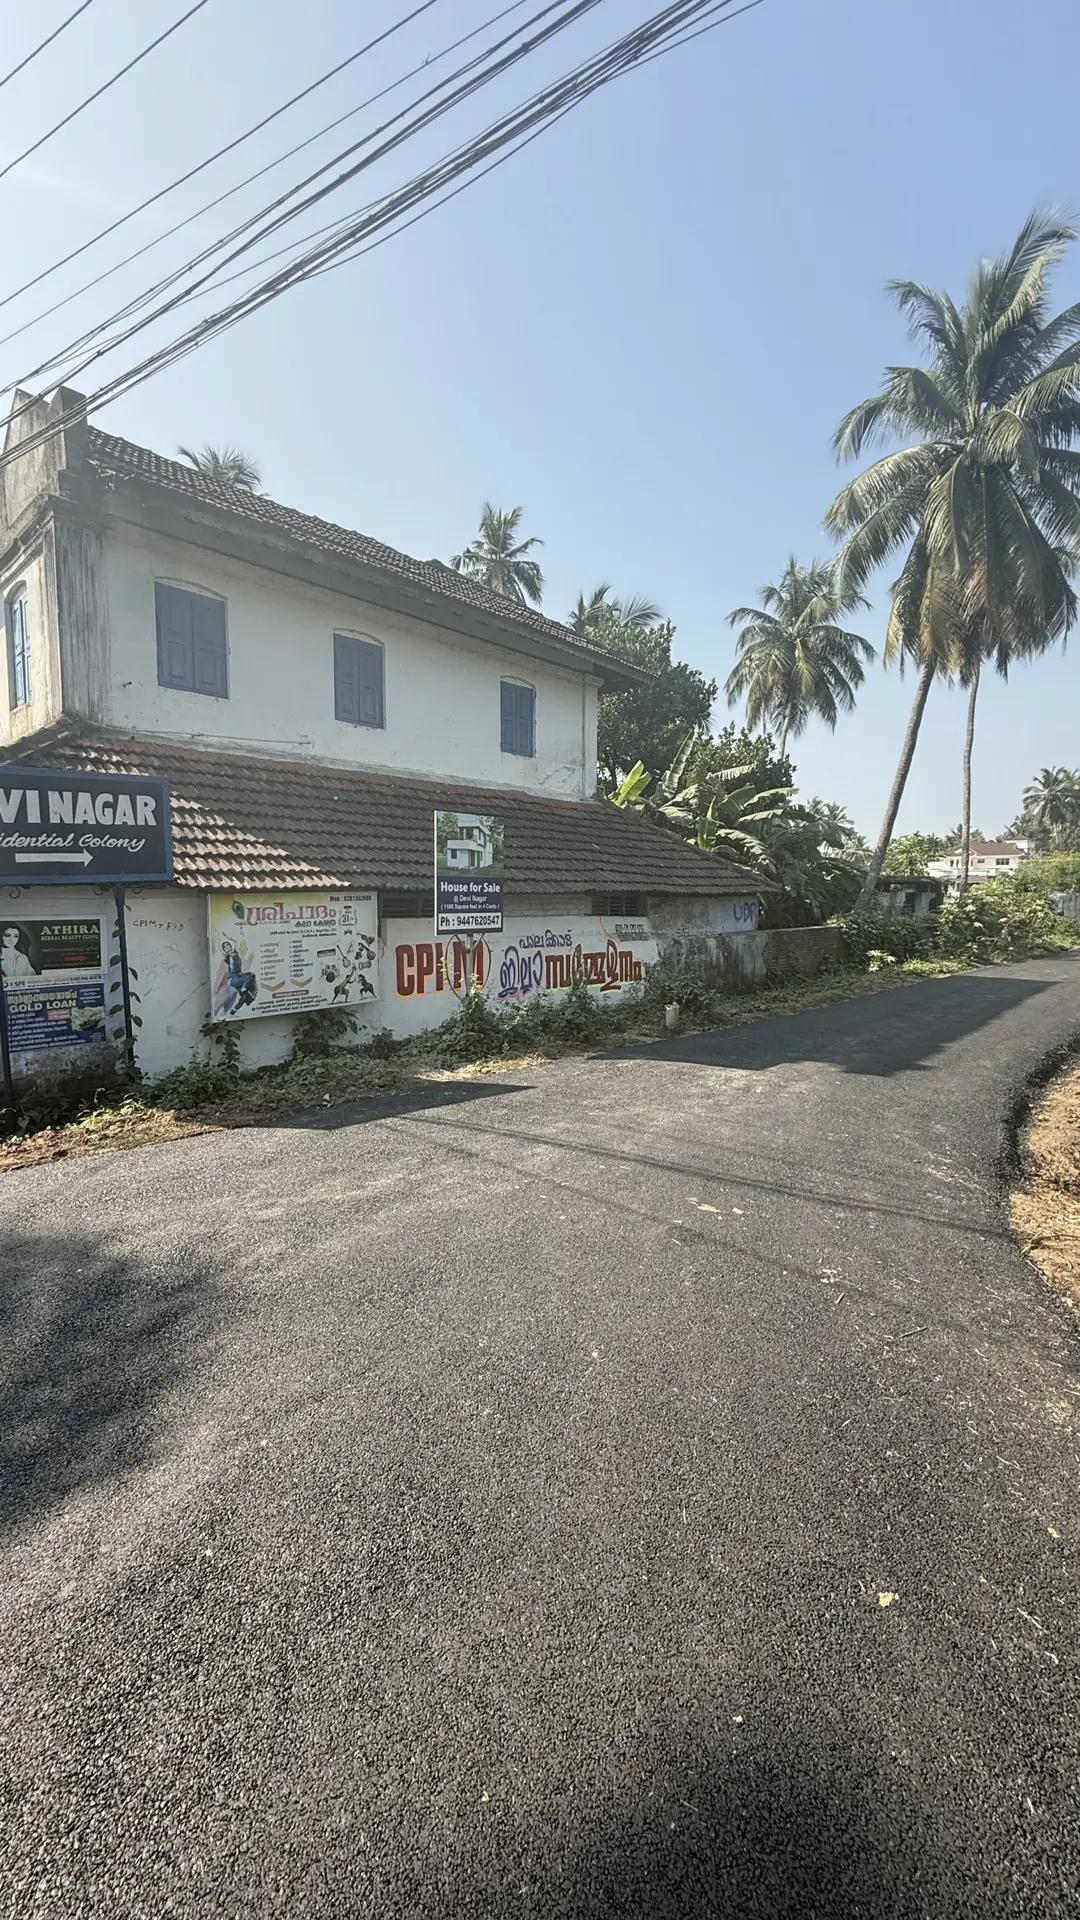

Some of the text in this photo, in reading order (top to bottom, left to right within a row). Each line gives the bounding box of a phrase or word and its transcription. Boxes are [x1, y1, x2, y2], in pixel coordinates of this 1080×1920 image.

[48, 791, 157, 826] NAGAR
[79, 833, 146, 852] Colony
[440, 881, 501, 893] House for Sale
[472, 895, 487, 903] Nagar
[440, 916, 451, 927] Ph
[456, 915, 500, 926] 9447620547
[40, 924, 100, 936] ATHIRA
[519, 929, 573, 949] പാലക്കാട്
[498, 945, 543, 998] ജില്ലാ
[9, 1000, 77, 1013] GOLD LOAN
